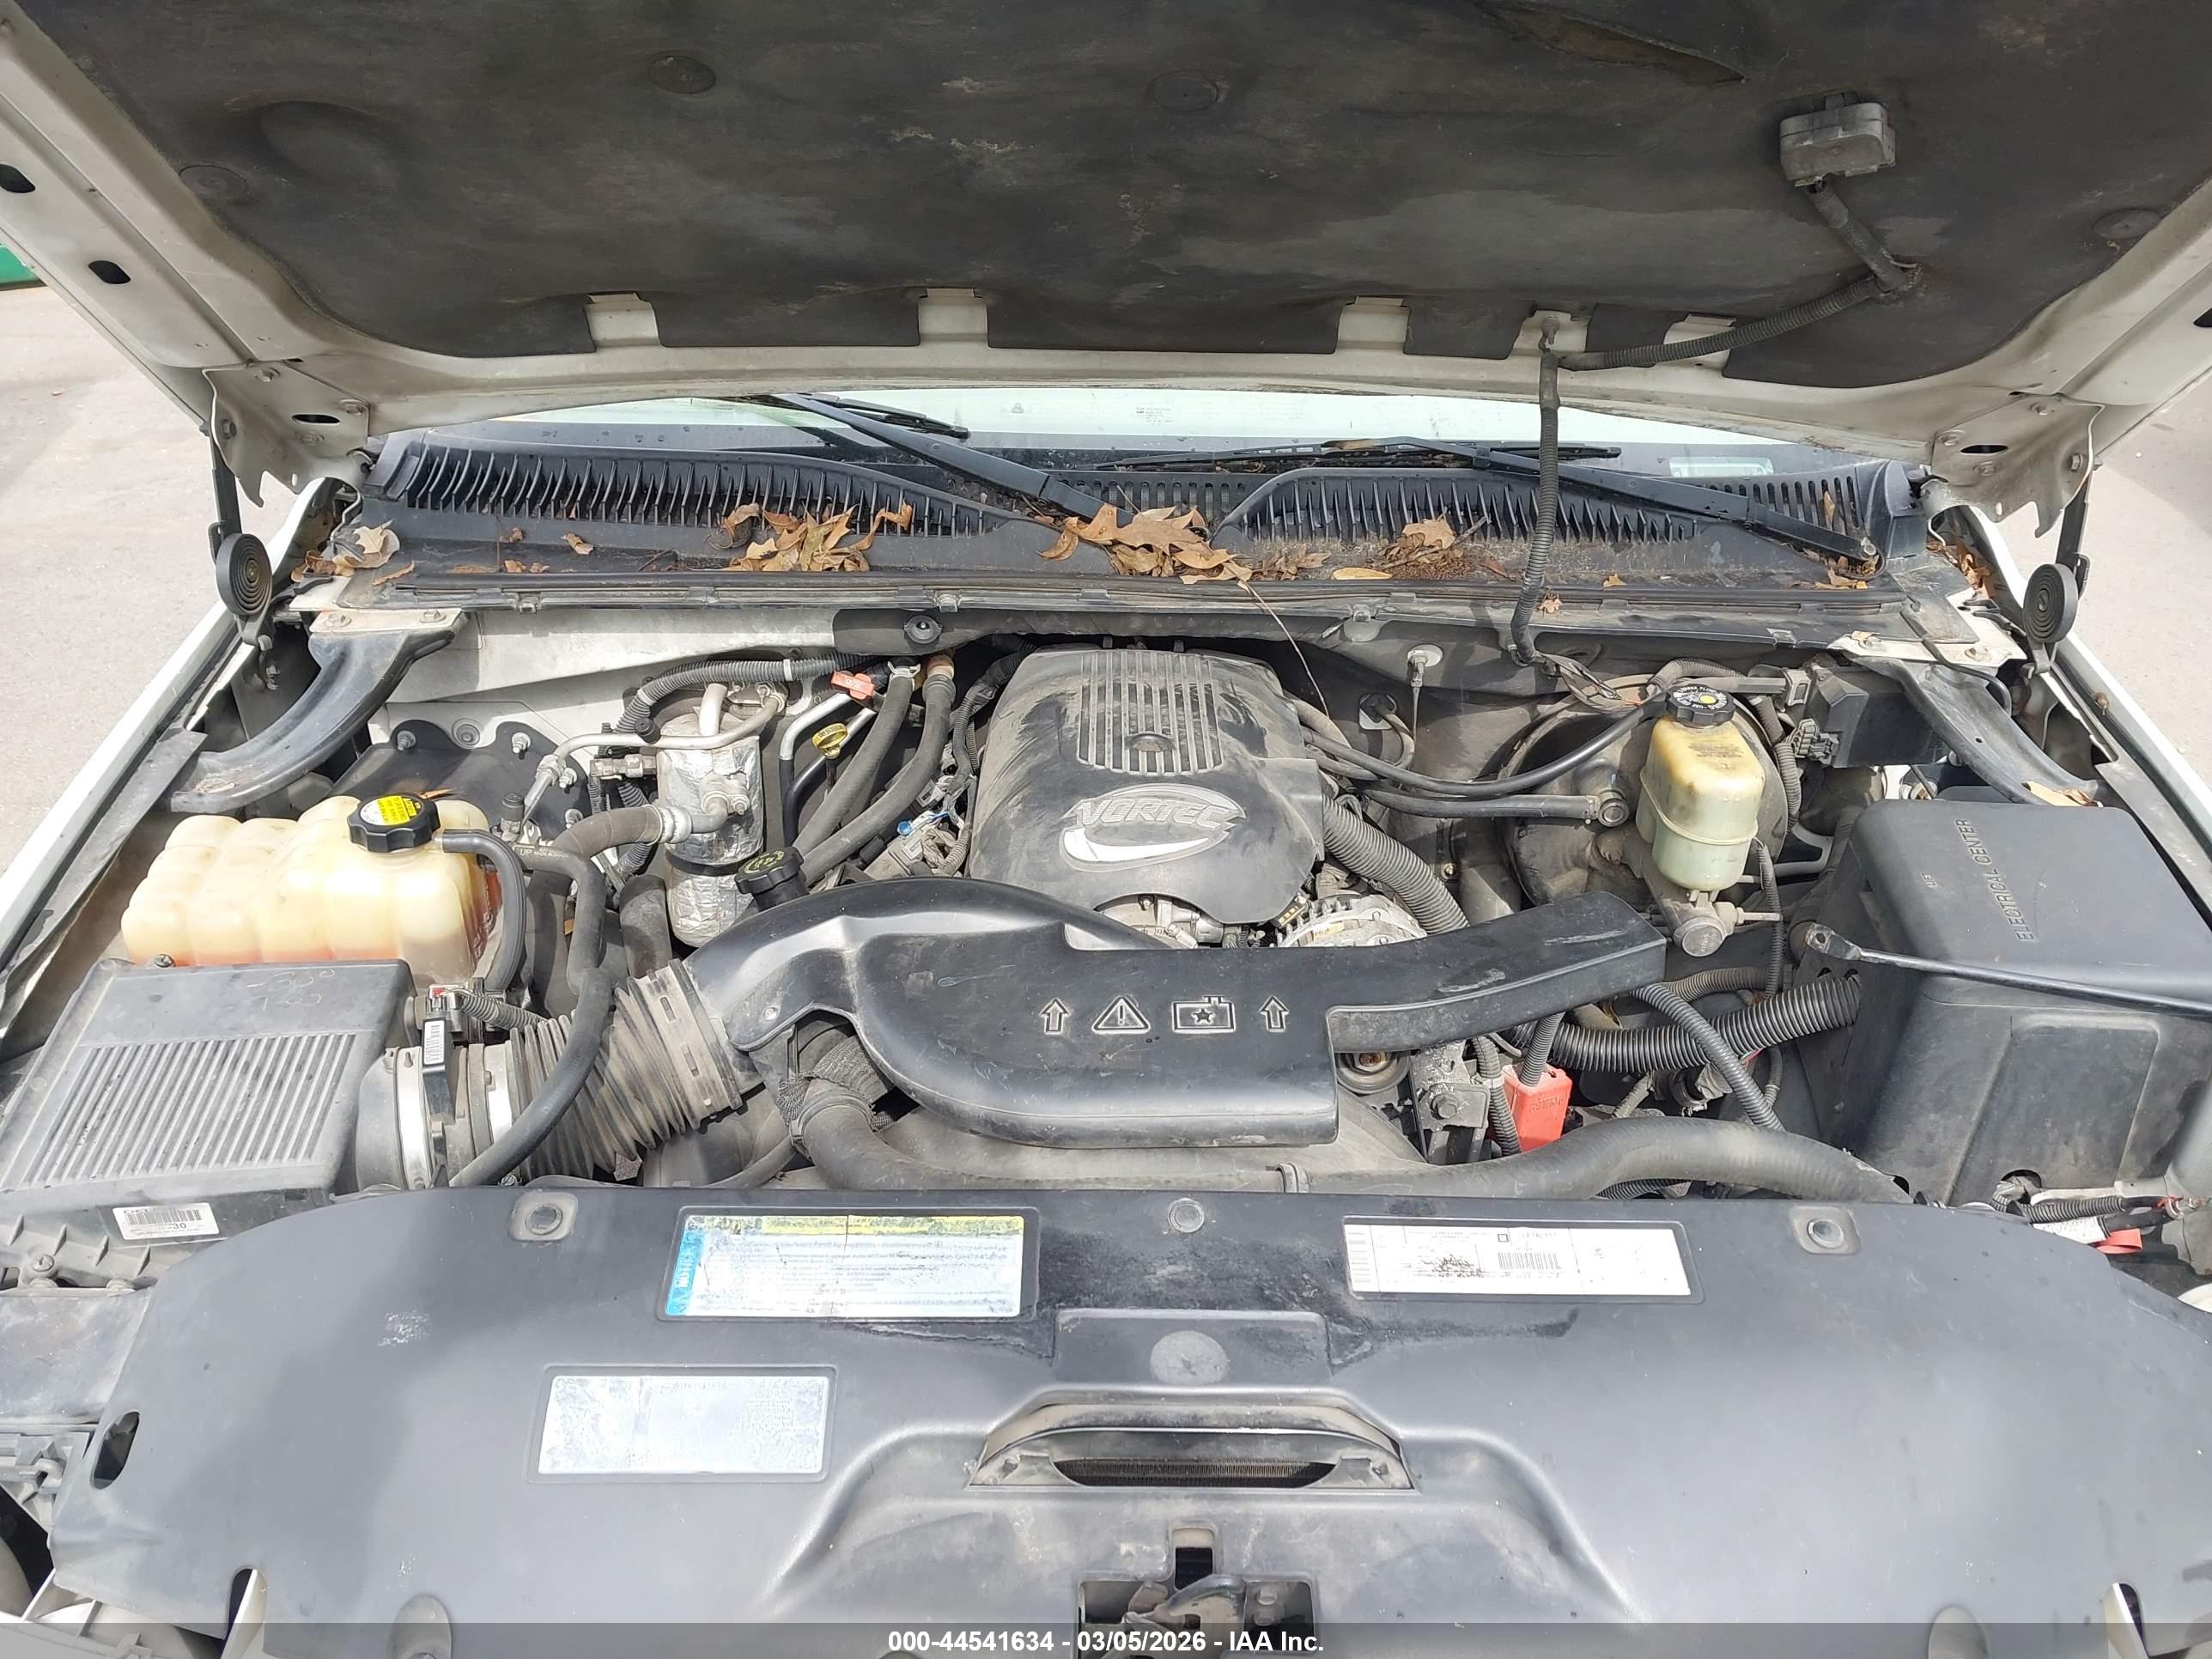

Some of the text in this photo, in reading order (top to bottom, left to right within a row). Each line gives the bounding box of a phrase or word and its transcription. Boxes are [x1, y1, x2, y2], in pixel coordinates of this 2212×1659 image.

[1075, 798, 1230, 830] VORTEC
[520, 848, 532, 857] UP
[1954, 818, 2035, 941] ELECTRICAL CENTER
